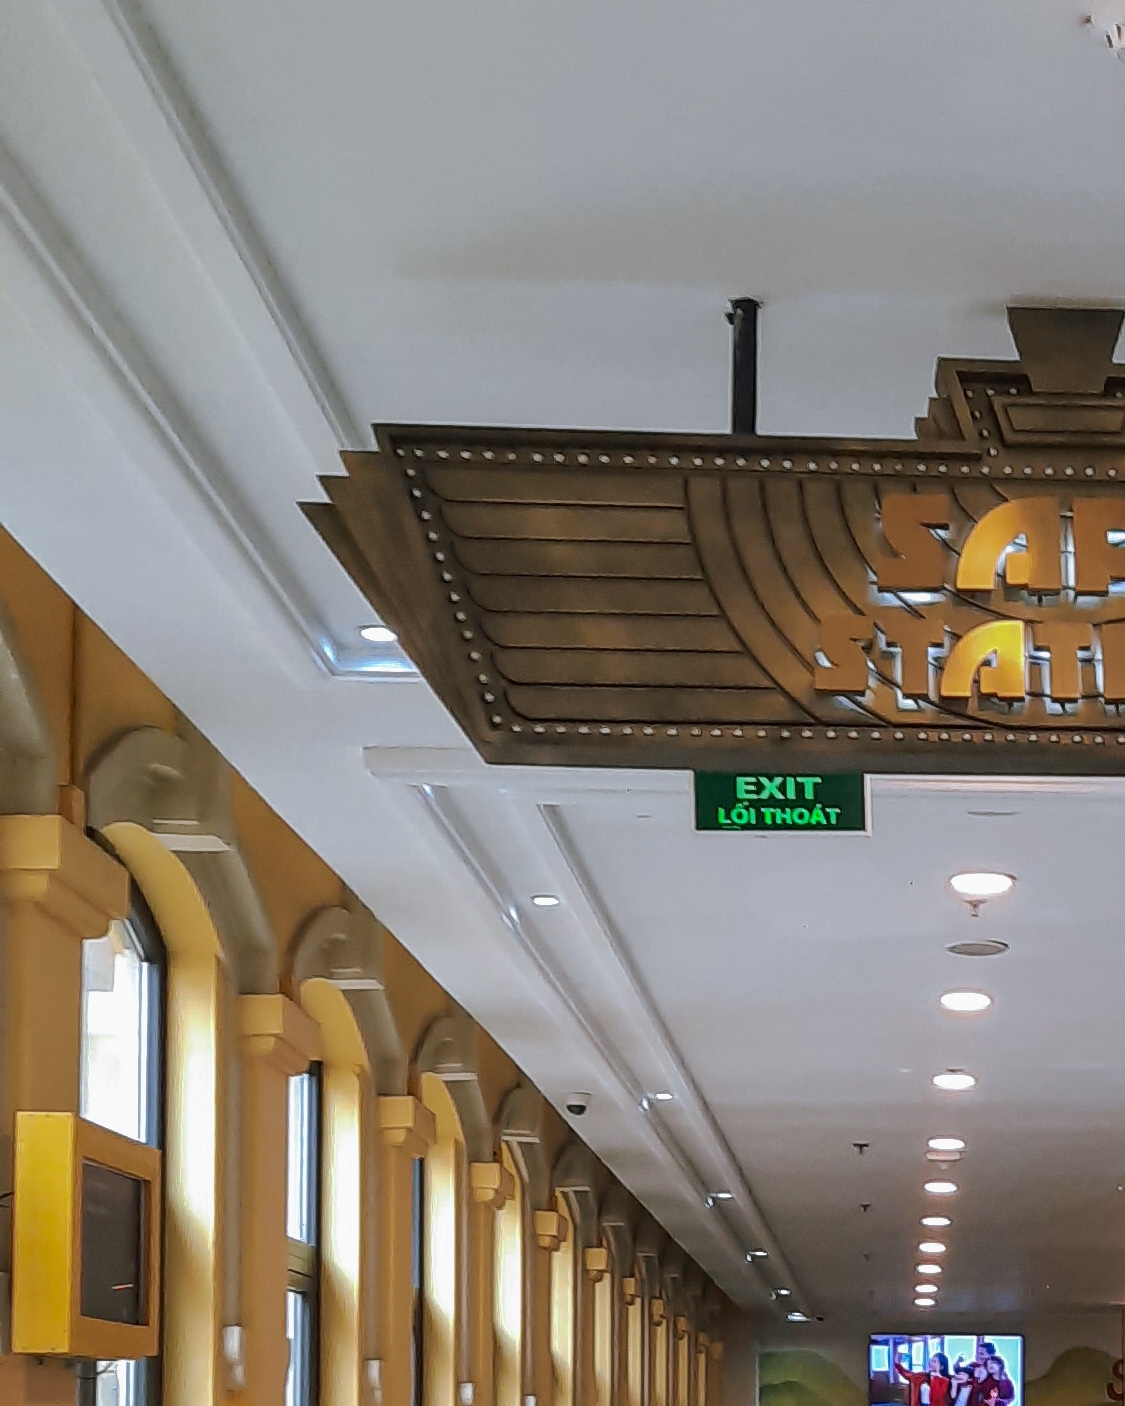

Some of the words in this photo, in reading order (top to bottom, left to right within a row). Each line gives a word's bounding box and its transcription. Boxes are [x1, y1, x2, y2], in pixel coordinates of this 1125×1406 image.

[735, 775, 823, 800] EXIT
[717, 801, 757, 825] LỐI
[760, 803, 842, 825] THOÁT
